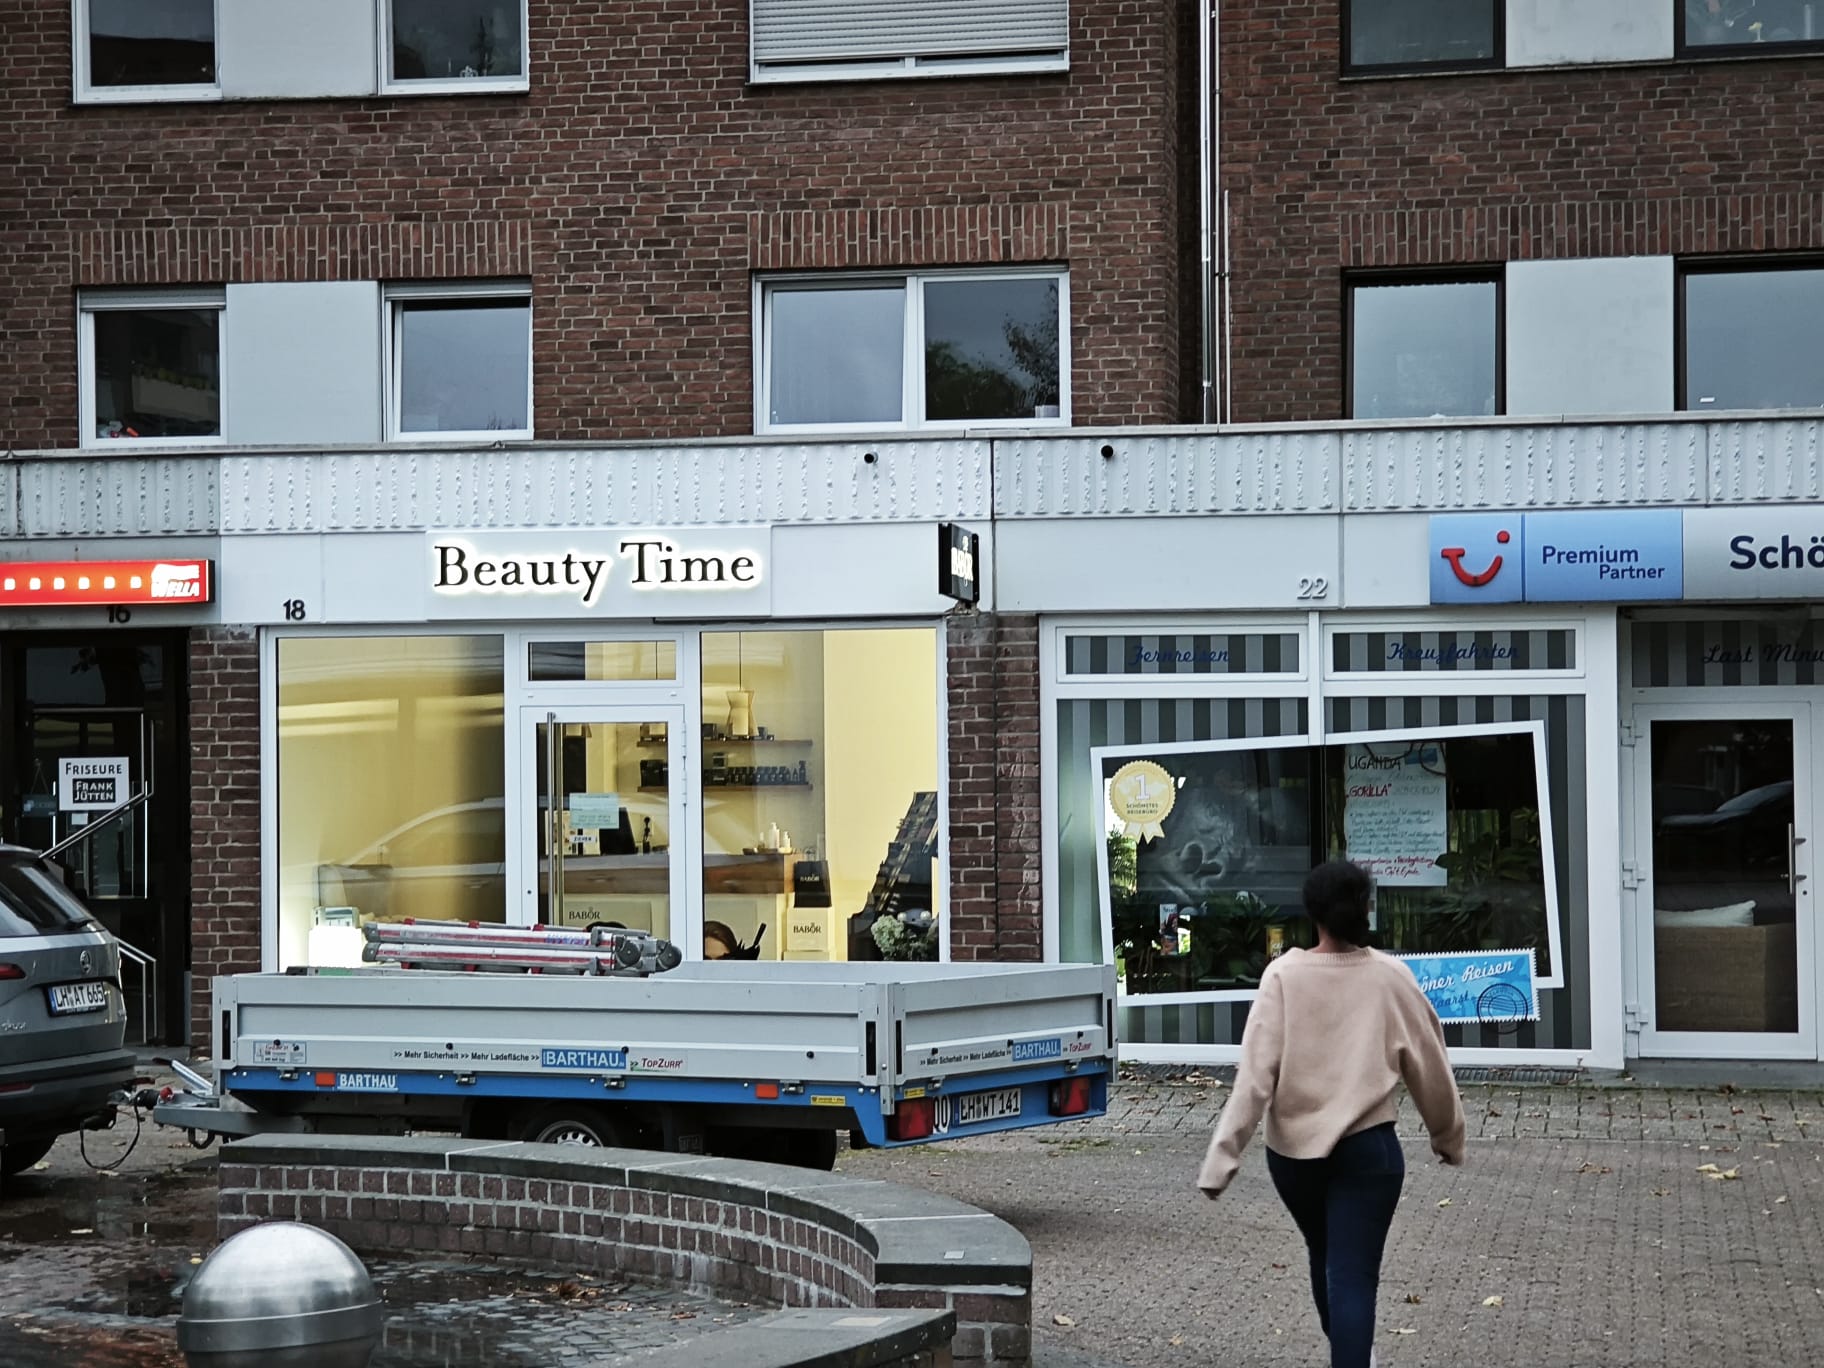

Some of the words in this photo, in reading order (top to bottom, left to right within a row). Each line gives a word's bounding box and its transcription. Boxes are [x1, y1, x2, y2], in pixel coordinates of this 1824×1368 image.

[1542, 543, 1639, 565] Premium
[434, 545, 606, 602] Beauty
[620, 541, 754, 584] Time
[1599, 564, 1666, 581] Partner
[151, 581, 200, 598] WELLA
[1297, 577, 1329, 600] 22
[283, 599, 306, 620] 18
[1129, 645, 1230, 666] Fernreisen
[1386, 641, 1520, 665] Kreuzfahrten
[1703, 644, 1753, 664] Last
[65, 762, 123, 775] FRISEURE
[1348, 755, 1401, 771] UGANDA
[75, 780, 113, 791] FRANK
[1135, 774, 1151, 801] 1
[74, 790, 114, 801] JÜTTEN
[569, 910, 601, 920] BABOR
[793, 924, 822, 934] BABOR
[1421, 975, 1455, 993] öner
[1462, 960, 1515, 984] Reisen
[404, 1051, 421, 1059] Mehr
[423, 1051, 459, 1060] Sicherheit
[471, 1052, 489, 1060] Mehr
[490, 1052, 529, 1061] Ladefläche
[1015, 1040, 1059, 1059] BARTHAU
[546, 1051, 620, 1067] BARTHAU
[339, 1073, 396, 1088] BARTHAU
[998, 1090, 1020, 1115] 141
